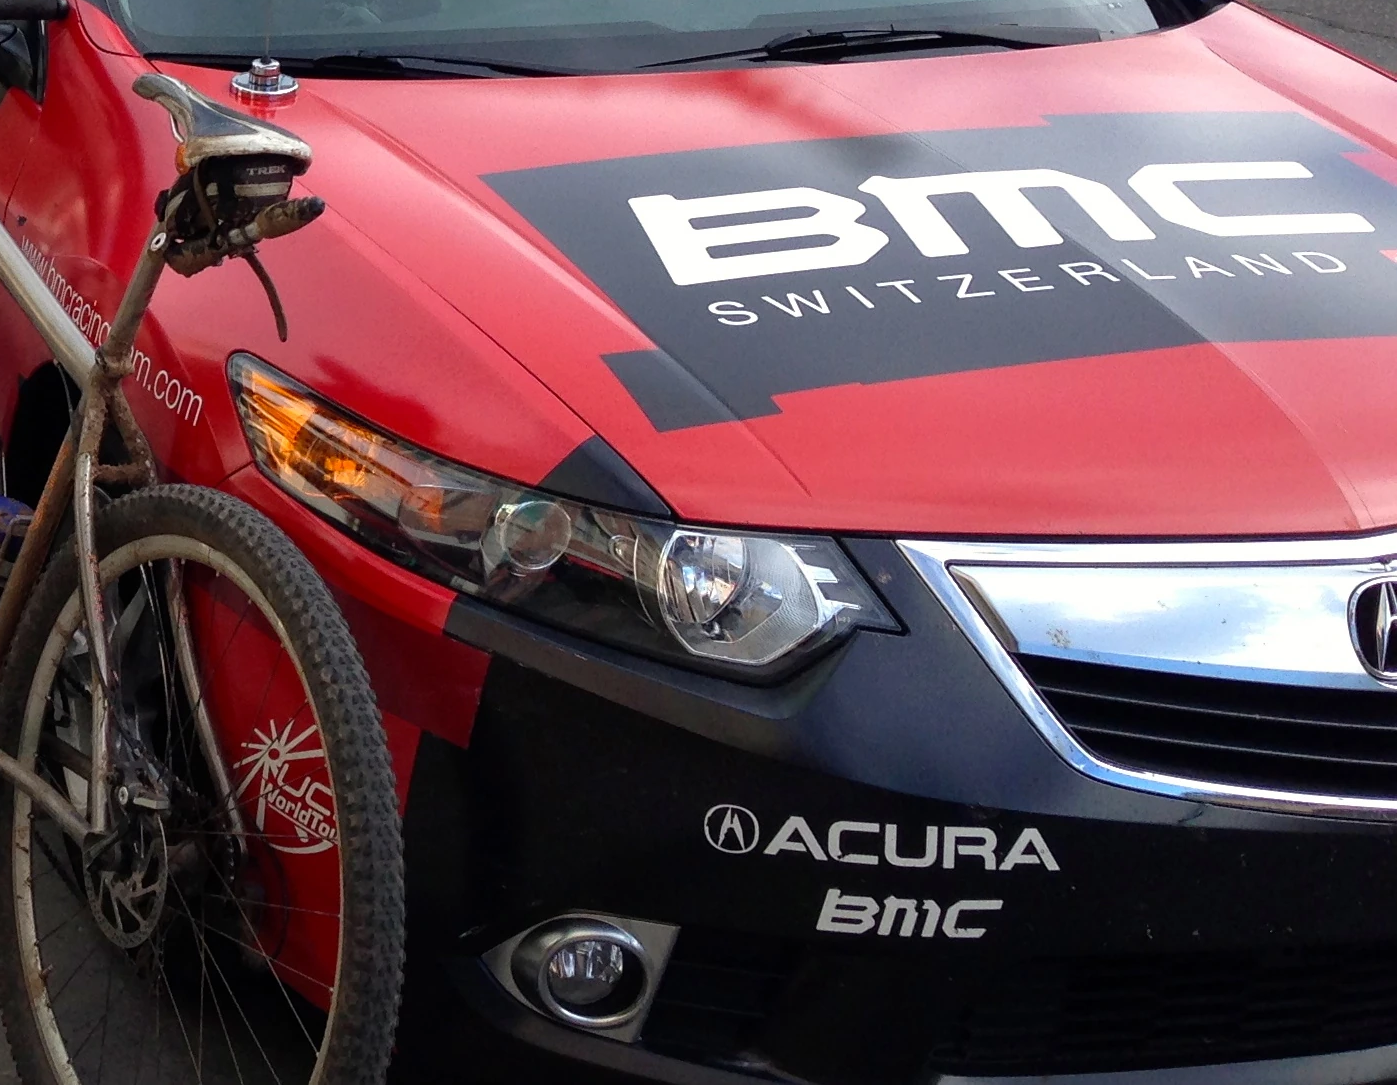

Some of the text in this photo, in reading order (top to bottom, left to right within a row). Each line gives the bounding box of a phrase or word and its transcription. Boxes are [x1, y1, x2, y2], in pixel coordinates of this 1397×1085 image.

[246, 165, 287, 176] TREK
[627, 161, 1377, 287] BMC
[707, 250, 1347, 327] SWITZERLAND
[277, 762, 336, 819] UC
[763, 816, 1061, 871] ACURA
[816, 888, 1004, 938] BMC
